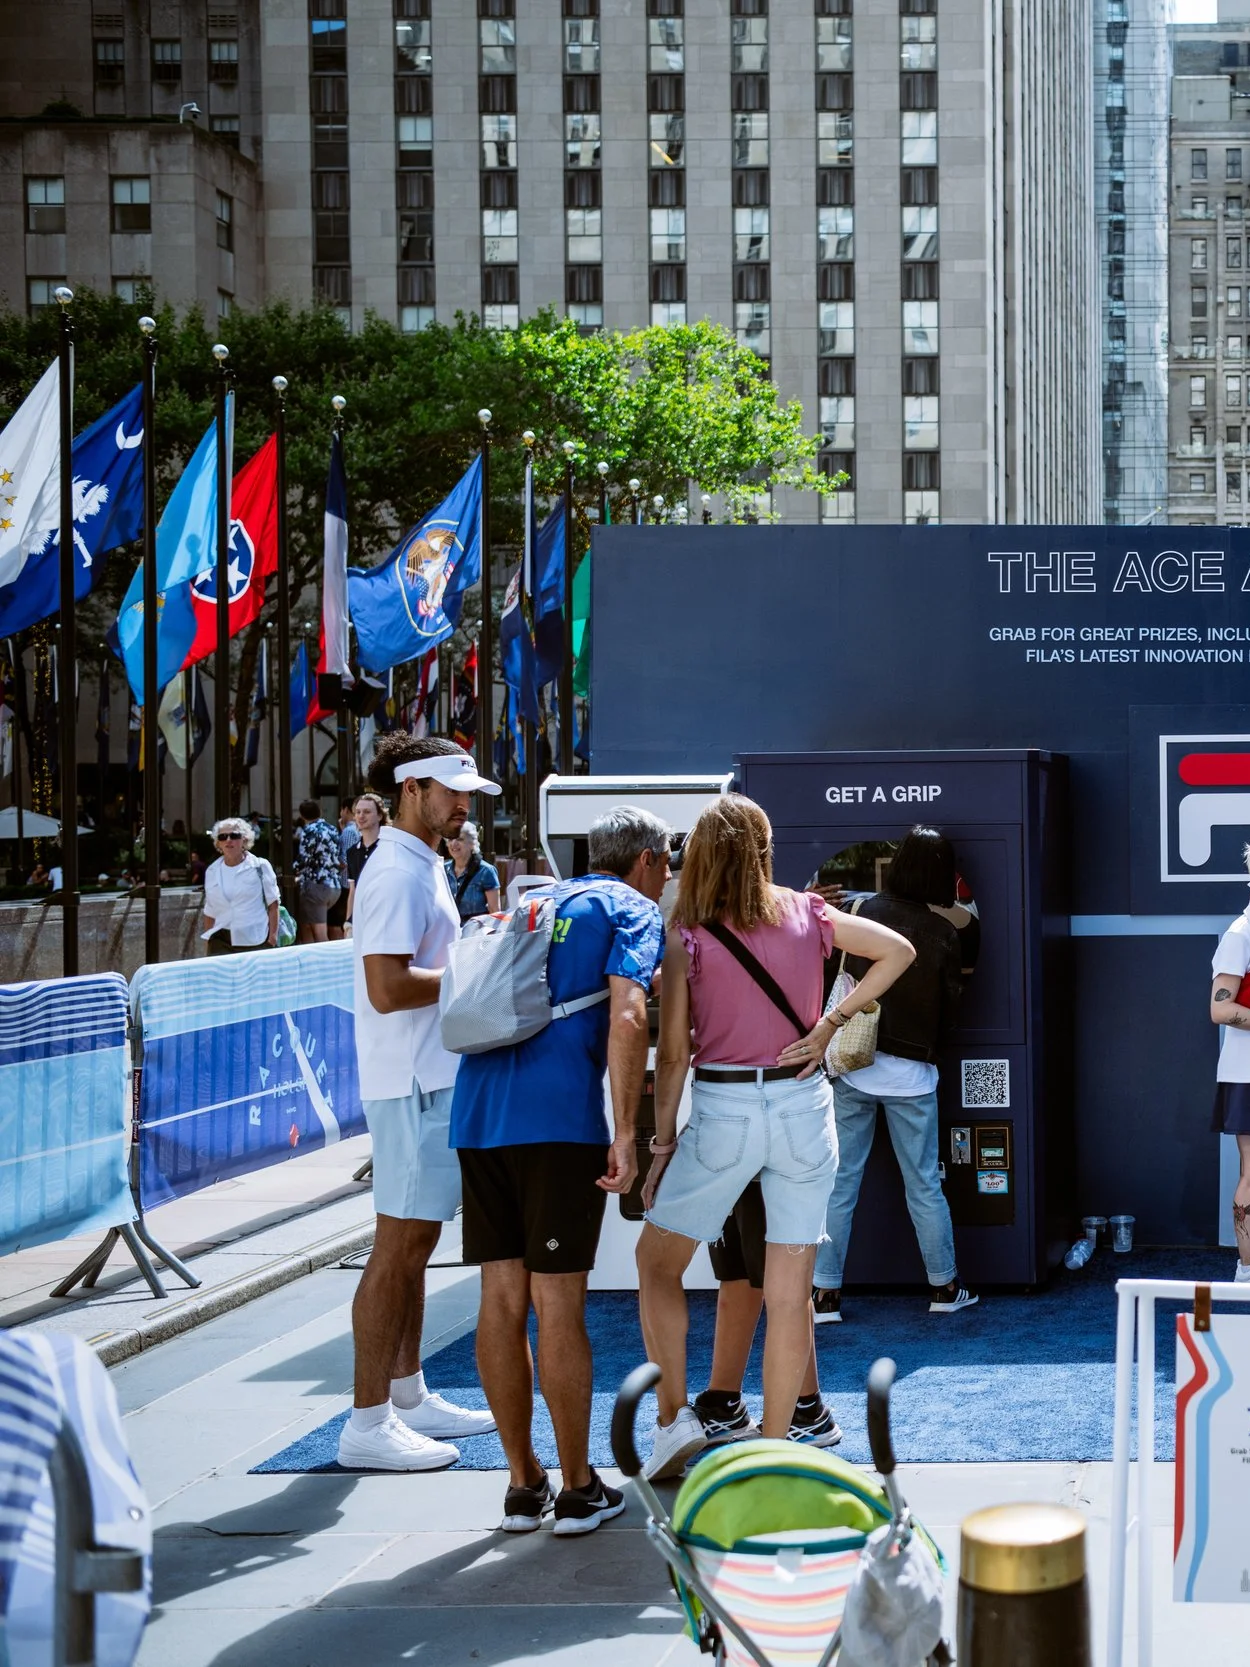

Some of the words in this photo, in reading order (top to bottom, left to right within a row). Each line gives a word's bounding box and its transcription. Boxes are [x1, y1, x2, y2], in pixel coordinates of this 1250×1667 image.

[988, 551, 1096, 593] THE
[1113, 550, 1225, 593] ACE
[989, 628, 1037, 642] GRAB
[1041, 628, 1075, 642] FOR
[1080, 628, 1134, 642] GREAT
[1139, 627, 1202, 644] PRIZES,
[1026, 649, 1075, 663] FILA'S
[1081, 649, 1140, 663] LATEST
[1145, 649, 1244, 663] INNOVATION
[461, 760, 476, 769] FIL
[825, 786, 867, 803] GET
[872, 787, 887, 803] A
[892, 785, 942, 803] GRIP
